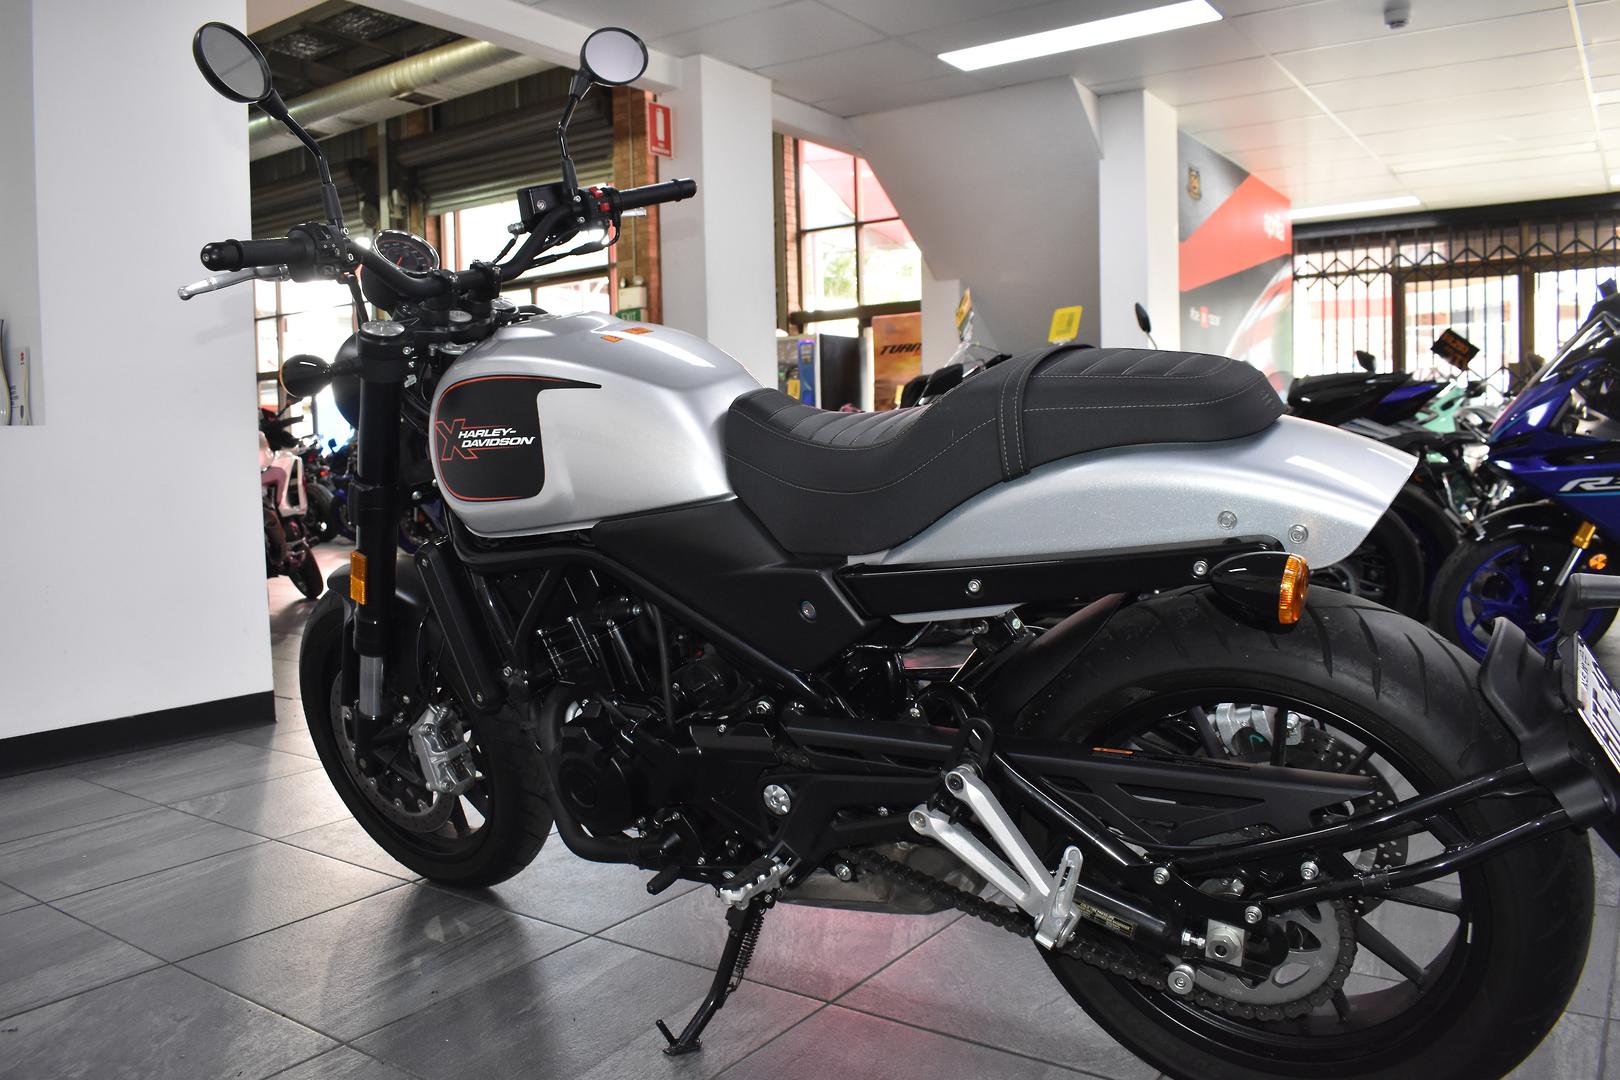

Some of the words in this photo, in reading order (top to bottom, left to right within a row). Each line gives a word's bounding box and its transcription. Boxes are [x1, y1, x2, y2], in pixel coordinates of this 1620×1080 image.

[458, 427, 517, 439] HARLEY-
[461, 436, 535, 448] DAVIDSON
[1559, 476, 1620, 492] R
